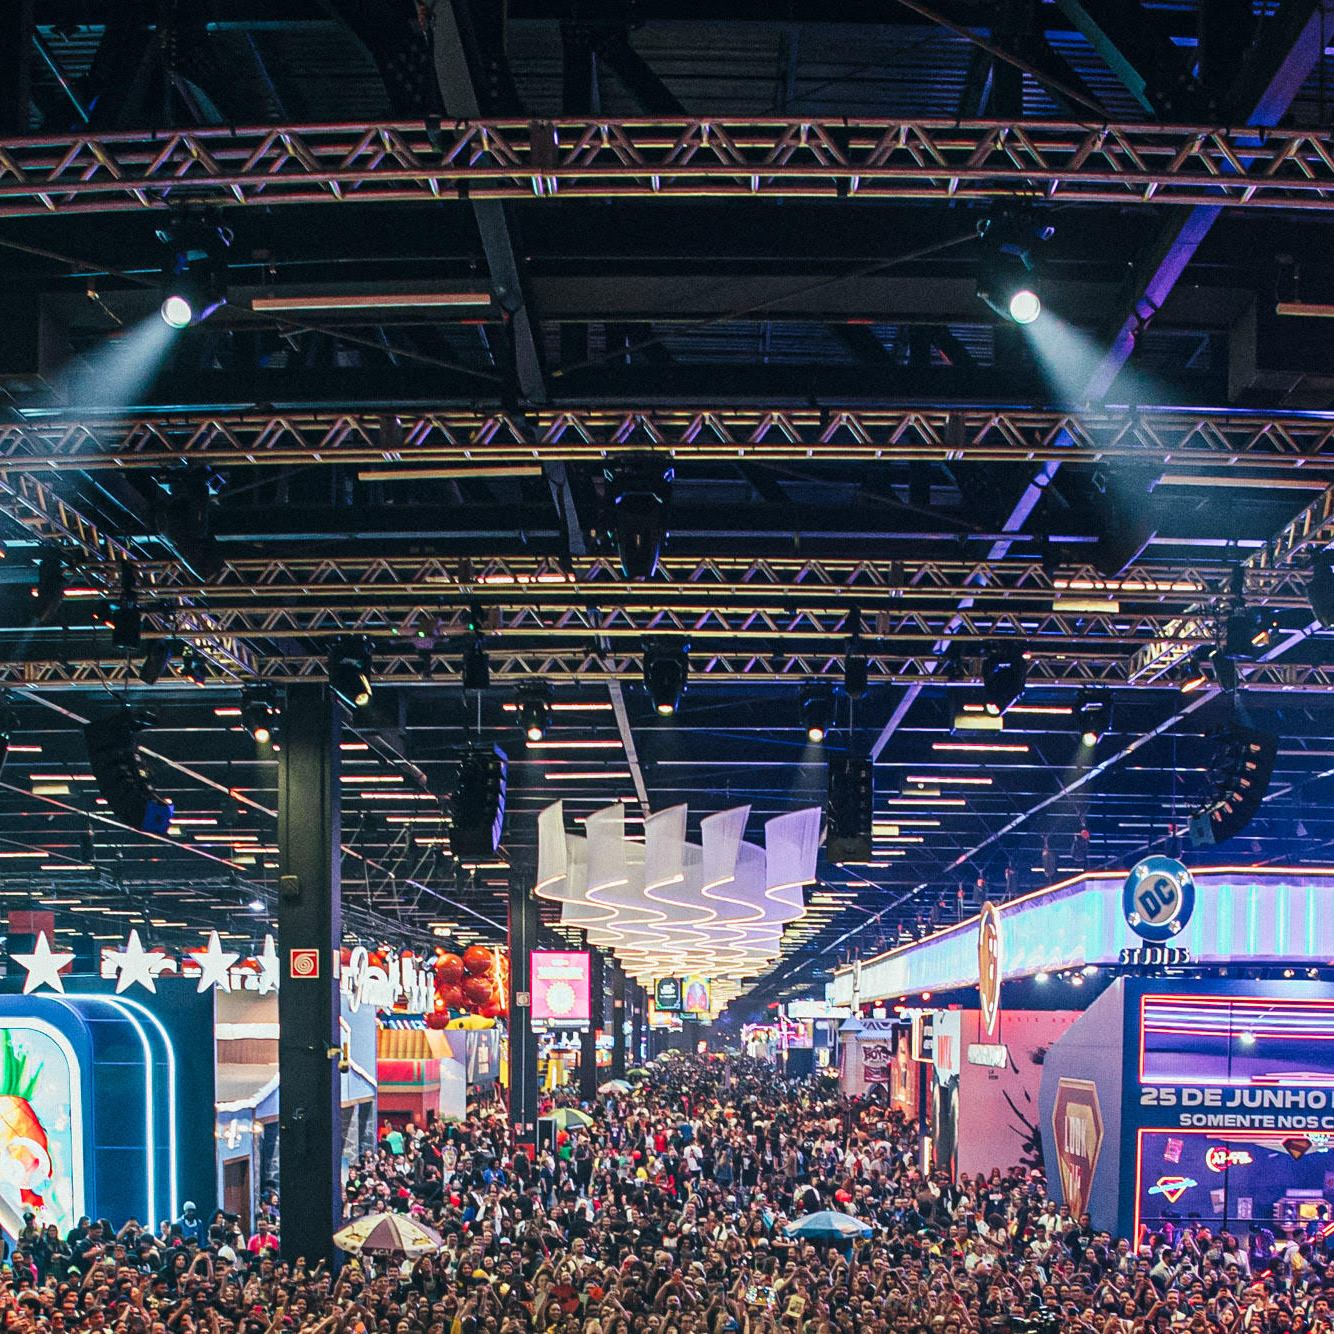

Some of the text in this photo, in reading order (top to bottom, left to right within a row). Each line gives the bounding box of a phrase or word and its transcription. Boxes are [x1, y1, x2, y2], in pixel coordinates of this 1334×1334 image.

[1138, 878, 1175, 920] DC
[1140, 1087, 1177, 1107] 25
[1181, 1088, 1223, 1108] DE
[1226, 1089, 1329, 1110] JUNHO
[1179, 1113, 1275, 1128] SOMENTE
[1278, 1115, 1319, 1129] NOS
